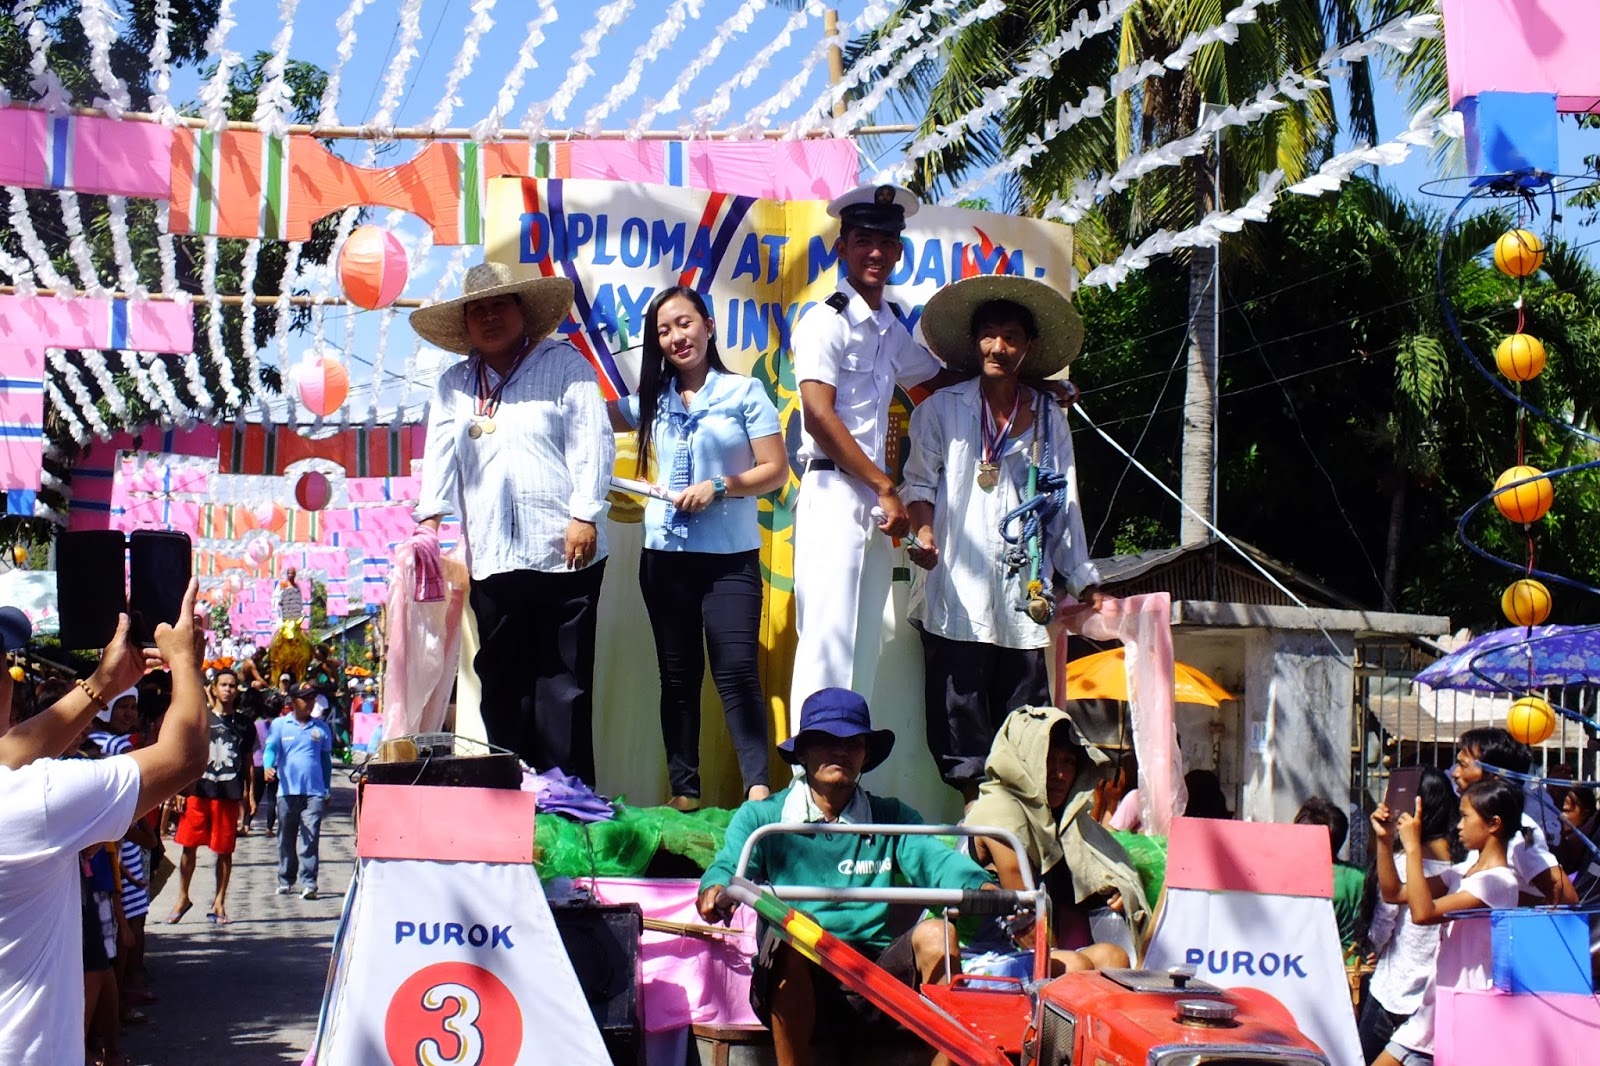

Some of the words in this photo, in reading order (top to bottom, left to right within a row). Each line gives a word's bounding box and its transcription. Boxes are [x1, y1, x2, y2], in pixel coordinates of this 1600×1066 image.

[519, 212, 713, 279] DIPLOMA
[731, 232, 789, 285] AT
[395, 920, 515, 950] PUROK
[1185, 948, 1308, 978] PUROK
[415, 982, 484, 1066] 3
